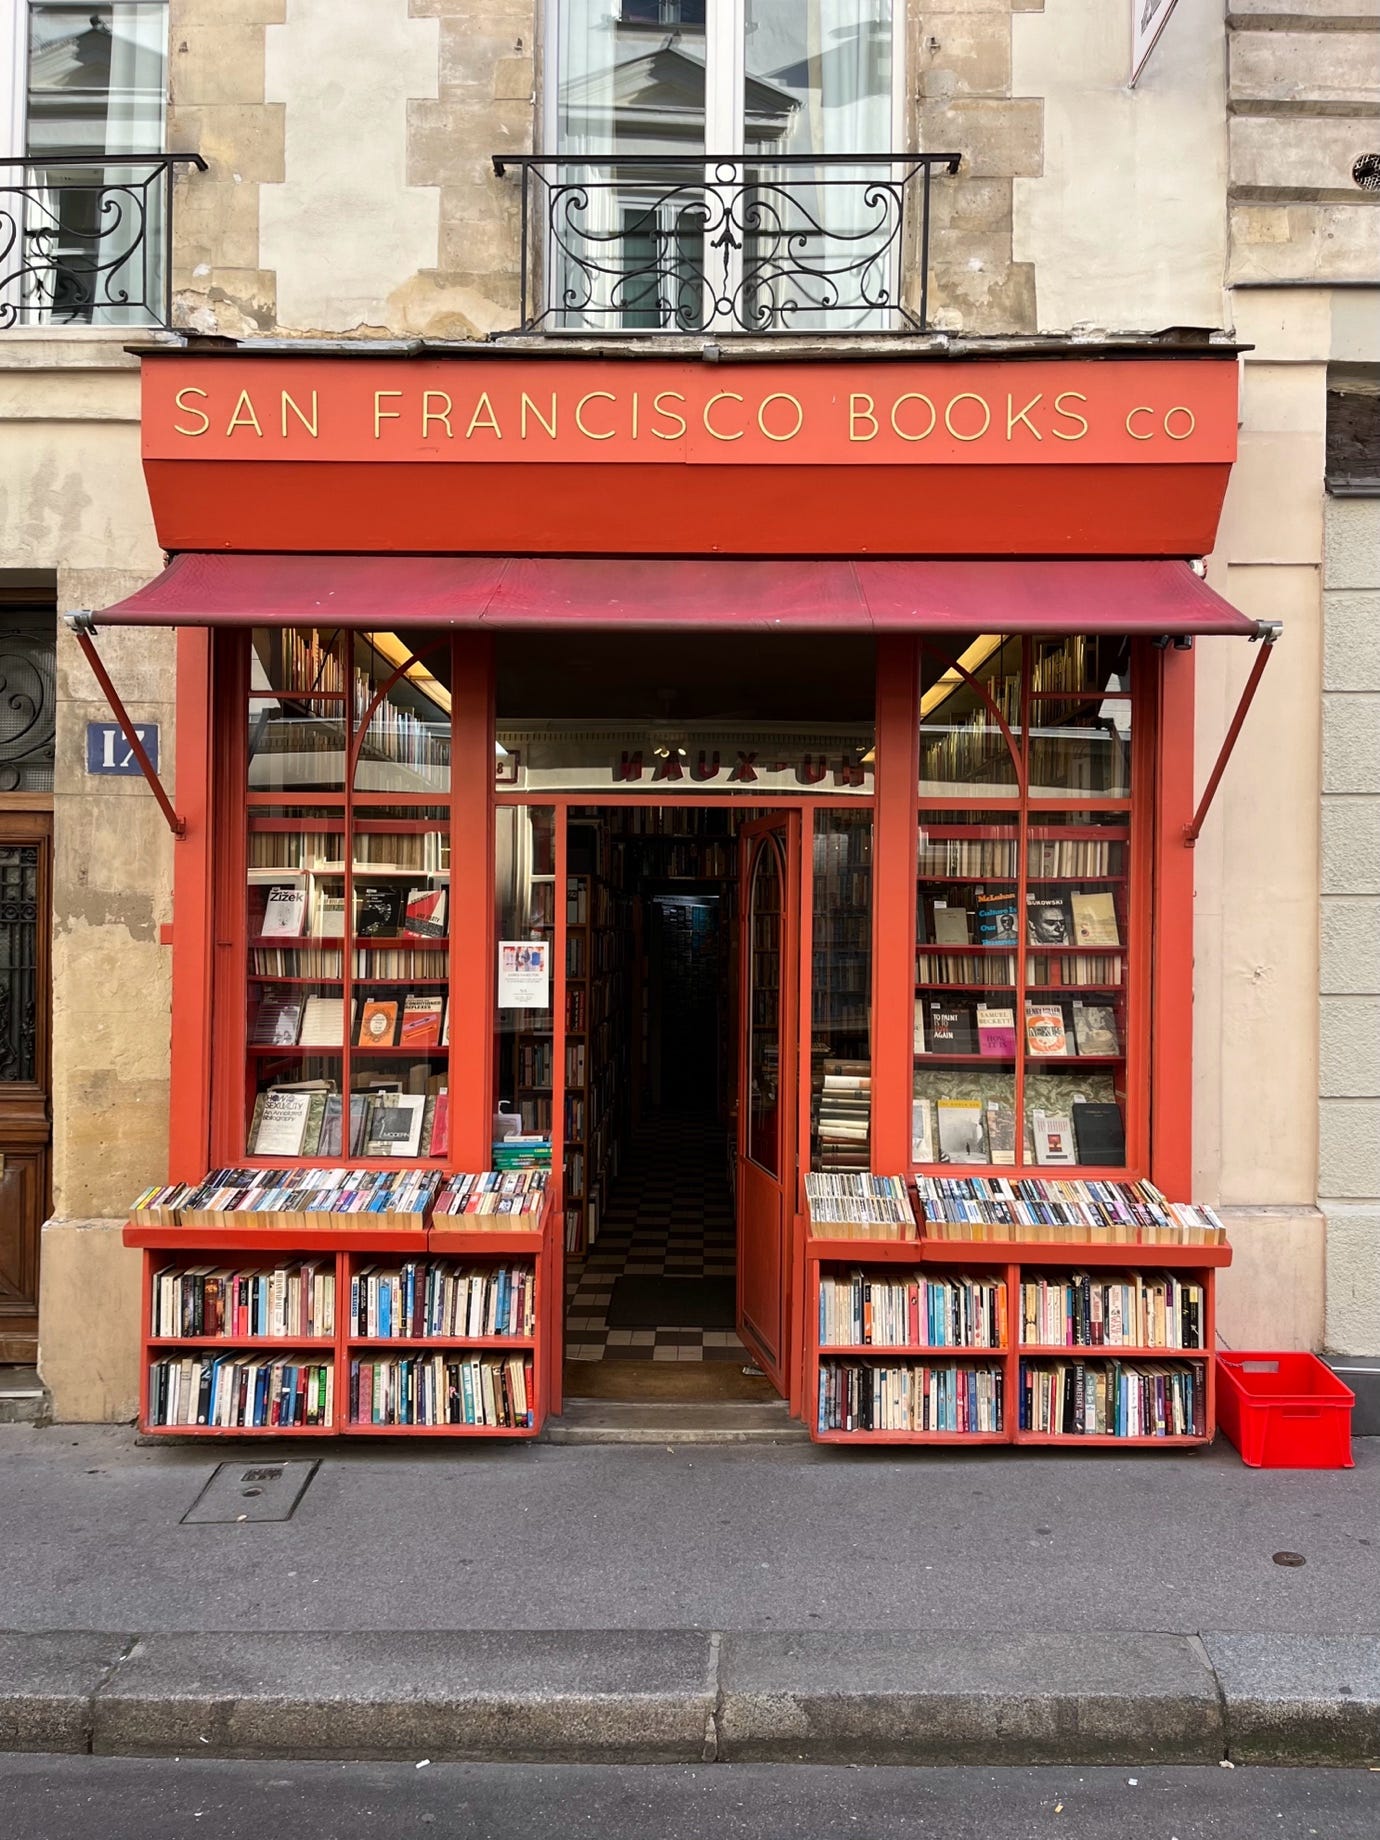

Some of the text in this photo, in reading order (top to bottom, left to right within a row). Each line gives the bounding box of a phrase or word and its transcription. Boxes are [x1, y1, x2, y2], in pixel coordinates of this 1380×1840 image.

[174, 387, 1195, 441] SAN FRANCISCO BOOKS CO
[270, 887, 304, 902] Žižek
[977, 892, 1016, 903] McLuhan
[978, 908, 1008, 917] Culture
[980, 924, 996, 932] Our
[933, 1013, 958, 1021] TO PAINT
